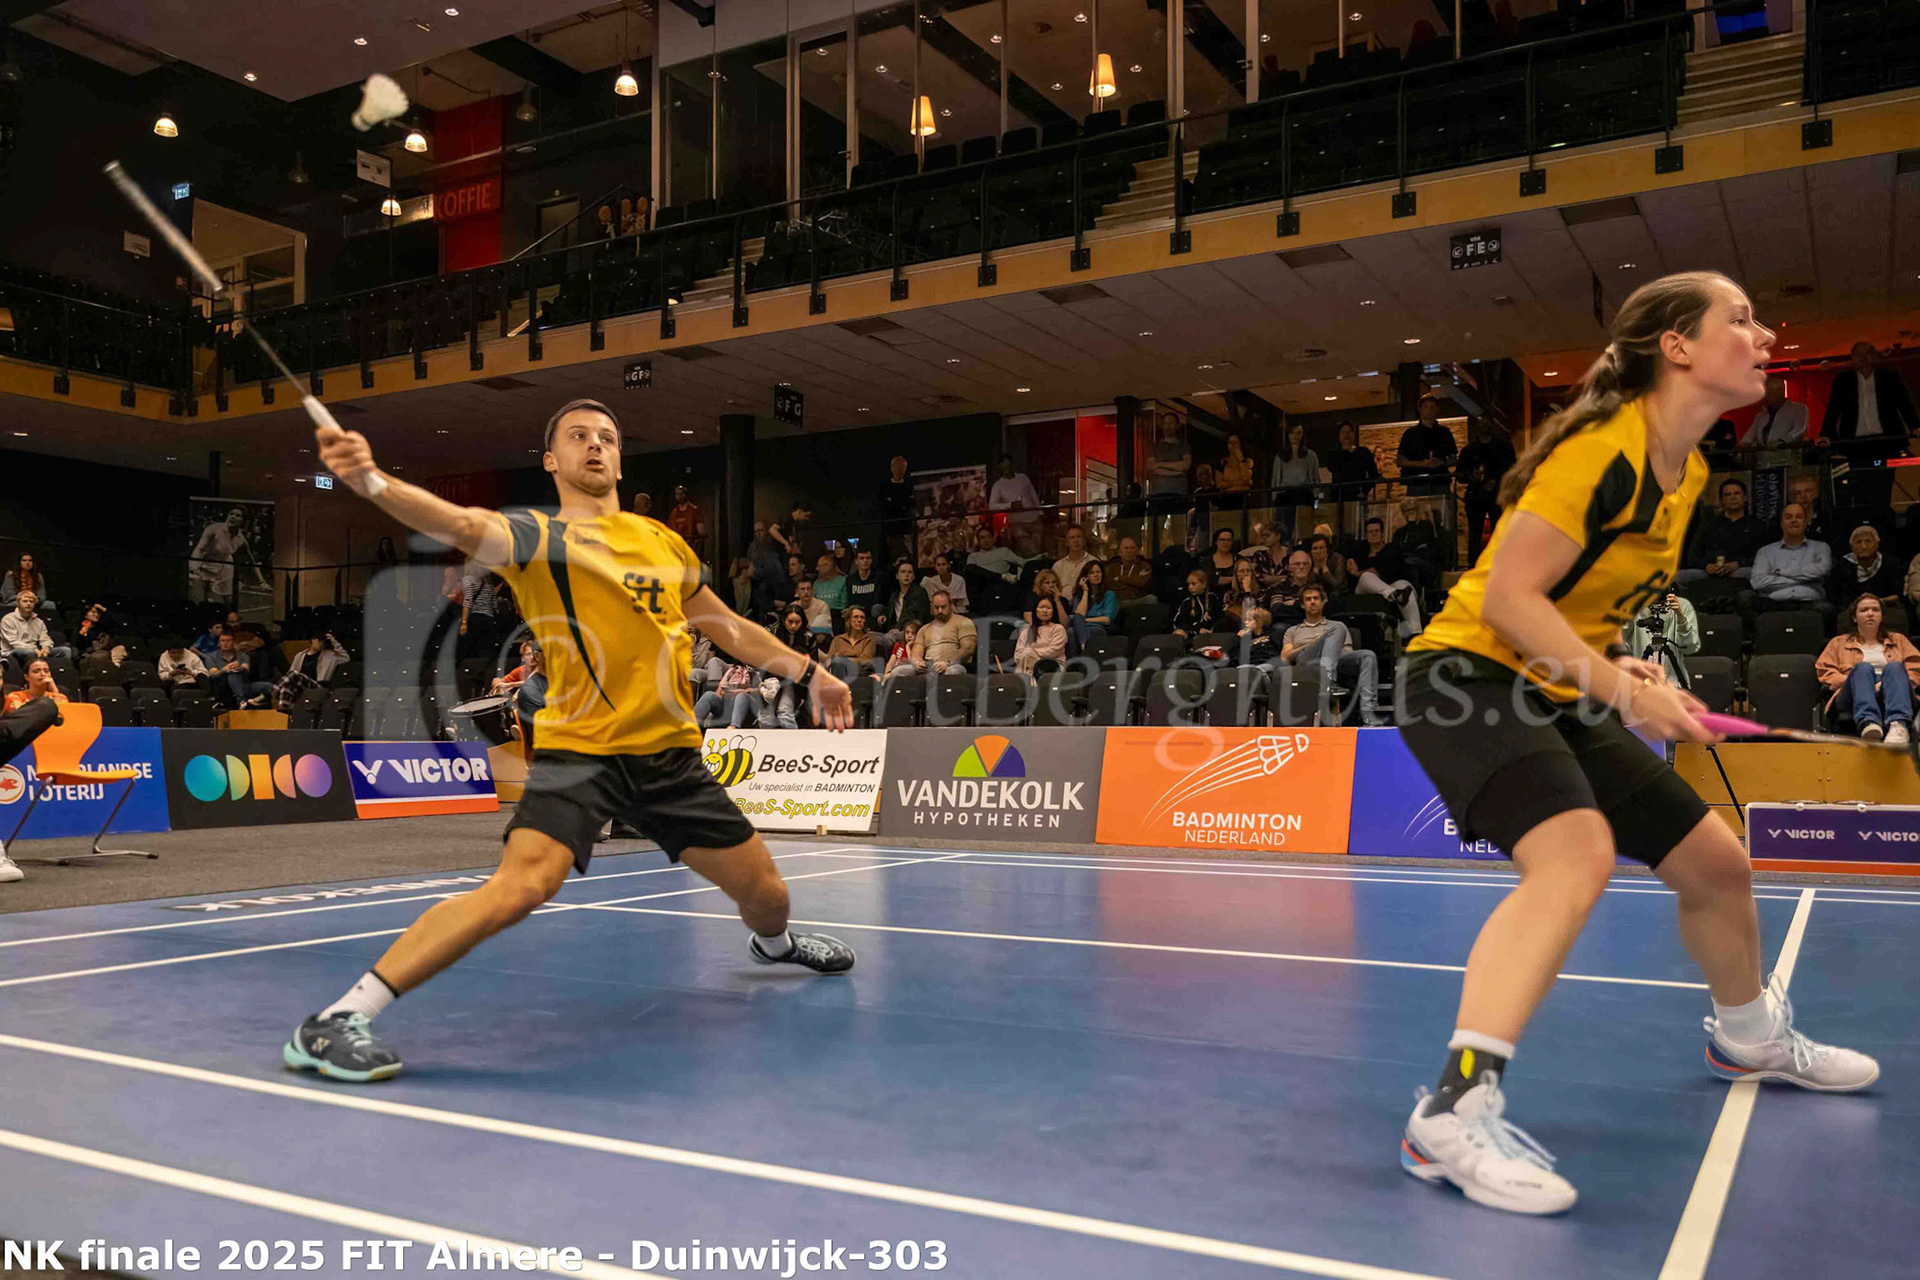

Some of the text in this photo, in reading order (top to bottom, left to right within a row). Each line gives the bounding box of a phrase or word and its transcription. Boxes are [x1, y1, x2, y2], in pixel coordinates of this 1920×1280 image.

[435, 182, 491, 218] KOFFIE
[388, 758, 489, 783] VICTOR
[758, 755, 880, 778] BeeS-Sport
[749, 782, 876, 793] Uw specialist in BADMINTON
[897, 780, 1085, 811] VANDEKOLK
[914, 812, 1060, 828] HYPOTHEKEN
[1172, 811, 1302, 831] BADMINTON
[1185, 829, 1286, 846] NEDERLAND
[1784, 829, 1835, 840] VICTOR
[1875, 831, 1920, 842] VICTO
